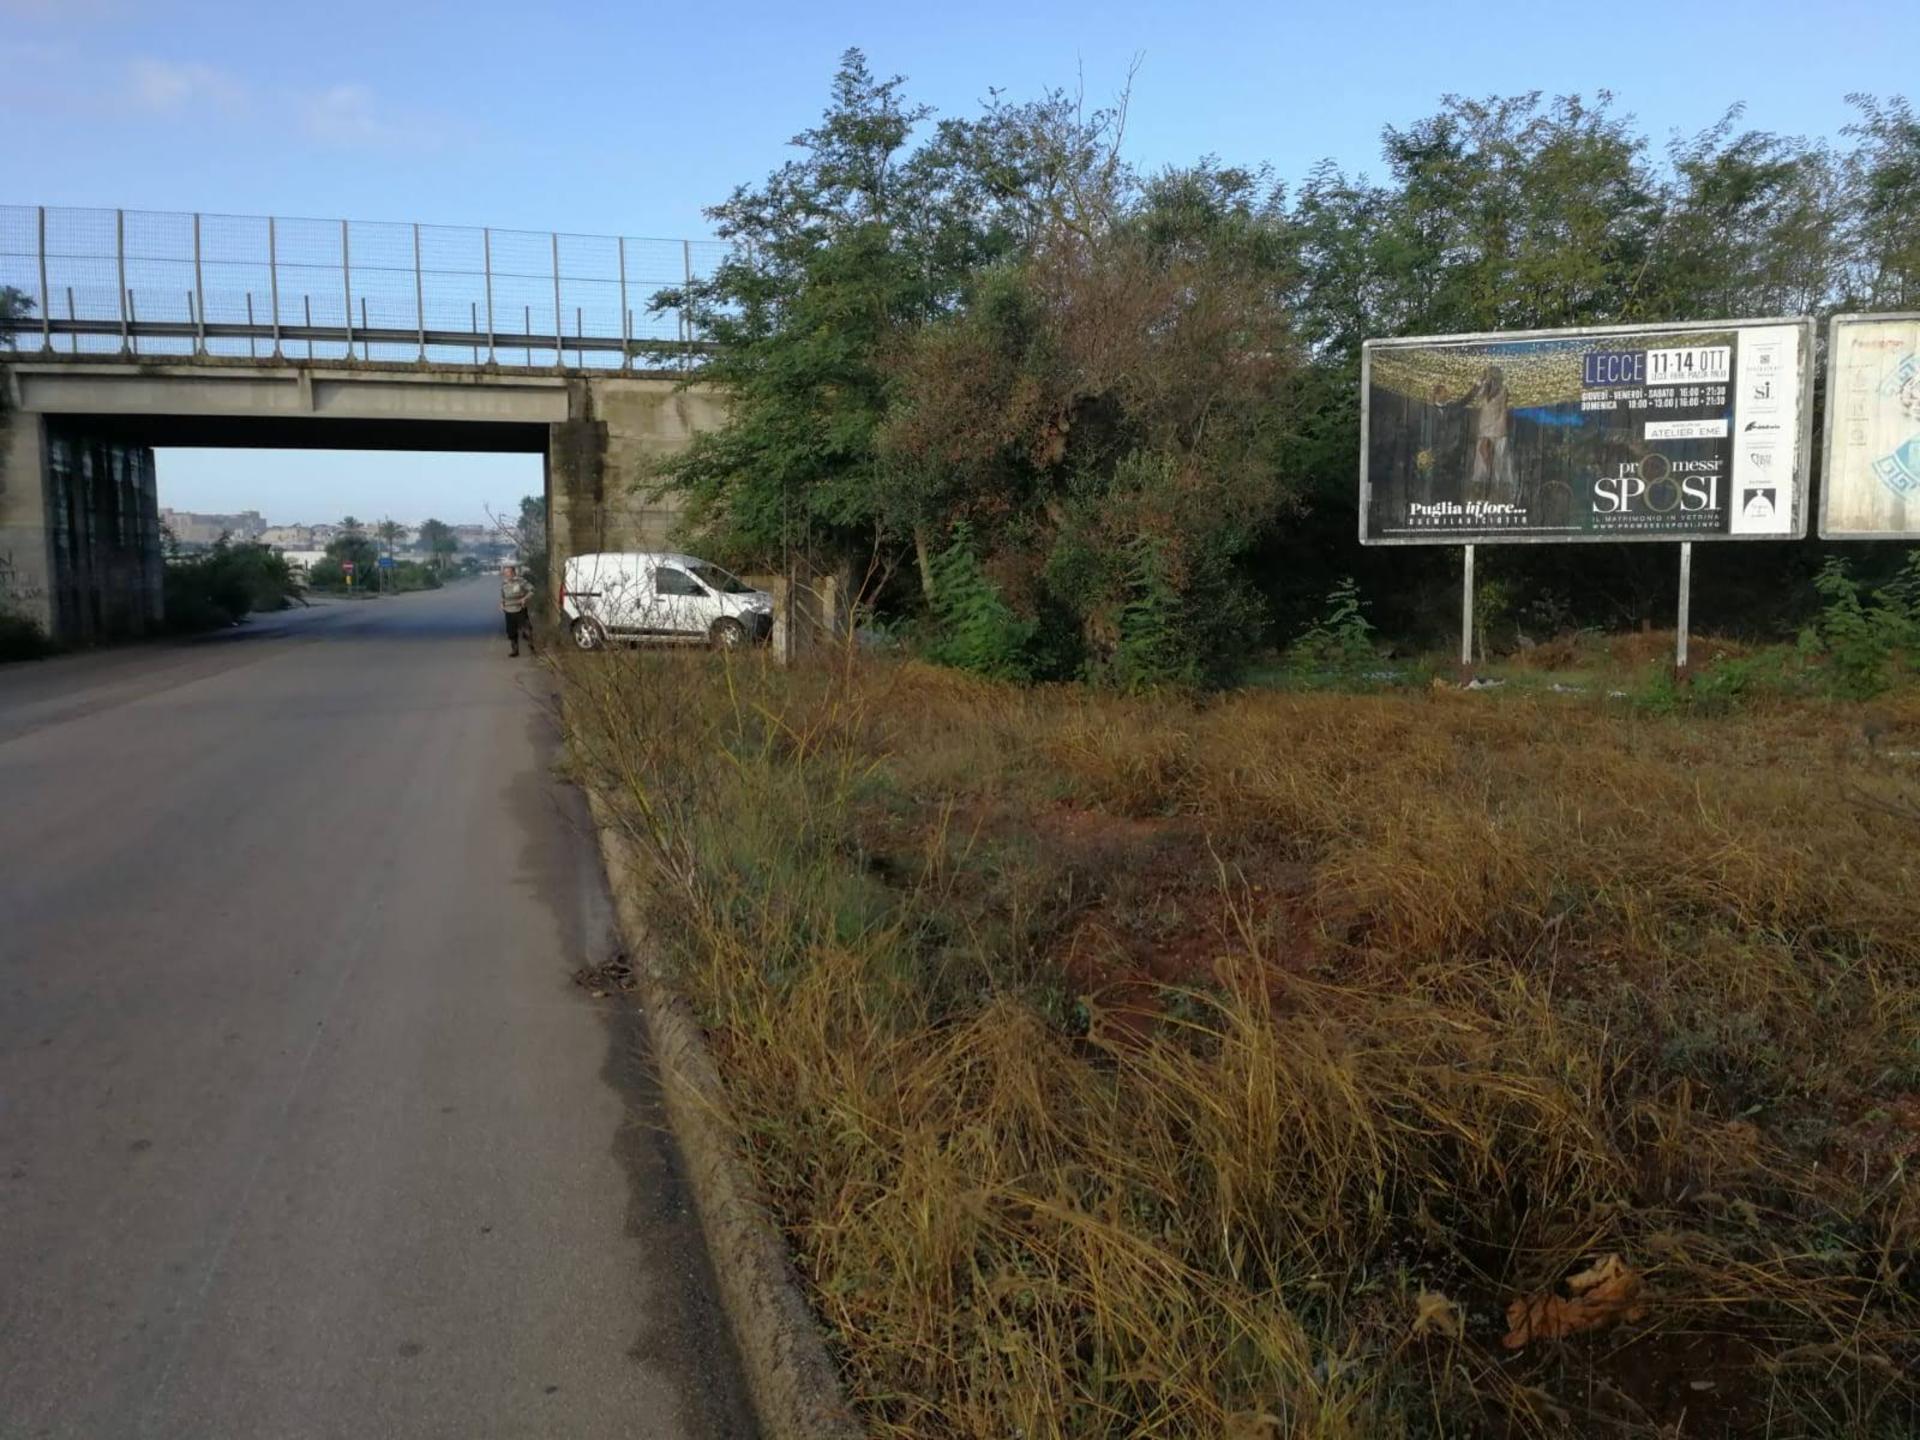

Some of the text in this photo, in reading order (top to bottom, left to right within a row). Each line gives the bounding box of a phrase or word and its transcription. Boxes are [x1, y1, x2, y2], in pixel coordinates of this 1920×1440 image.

[1585, 353, 1644, 383] LECCE
[1700, 350, 1725, 371] OTT
[1648, 388, 1675, 399] SABATO
[1651, 427, 1694, 438] ATELIER
[1592, 475, 1723, 513] SPOSI
[1410, 501, 1462, 517] Puglia
